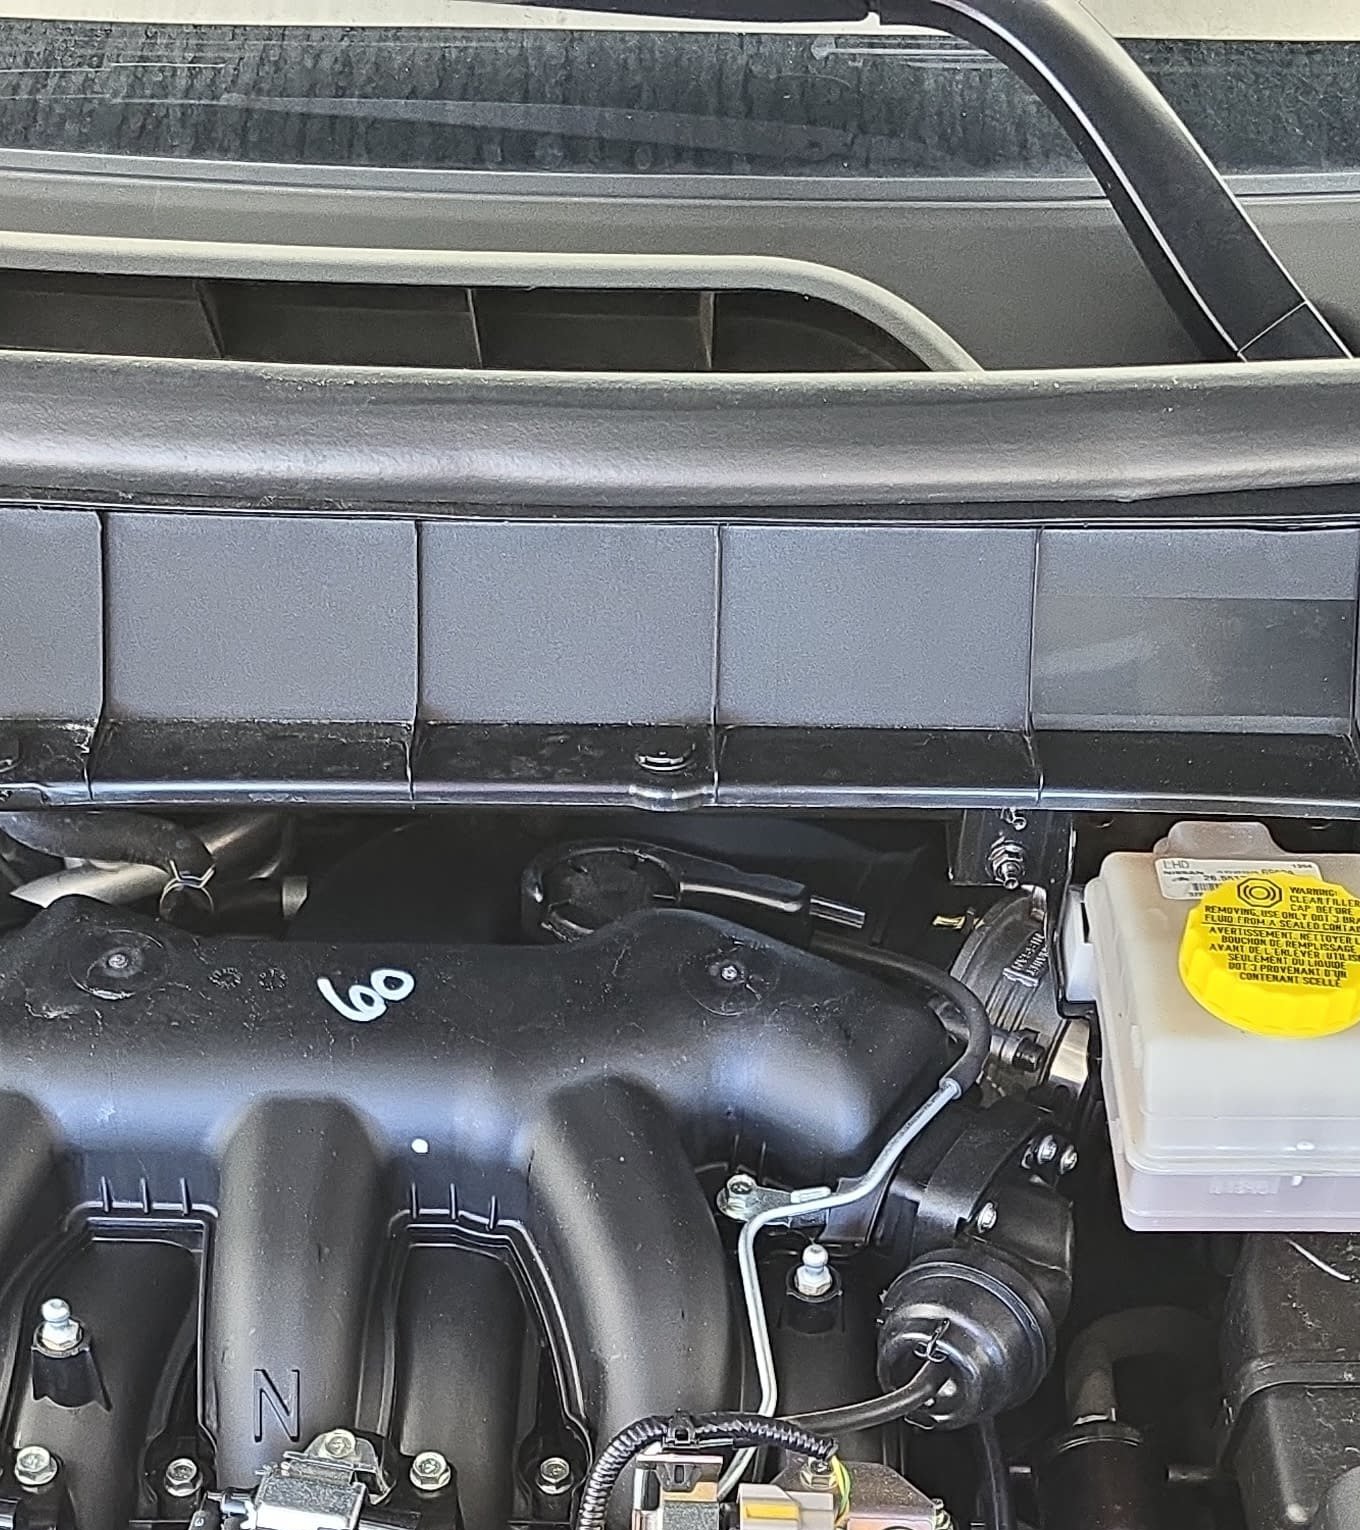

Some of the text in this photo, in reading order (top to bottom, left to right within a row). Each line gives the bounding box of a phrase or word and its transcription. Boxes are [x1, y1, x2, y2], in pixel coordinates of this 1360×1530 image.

[1163, 860, 1190, 869] LHD
[1290, 895, 1360, 908] CLEAN FILLER
[1261, 910, 1280, 918] USE
[1281, 911, 1307, 920] ONLY
[1311, 913, 1329, 922] DOT
[1333, 915, 1339, 923] 3
[1290, 904, 1353, 916] CAP BEFORE
[1205, 914, 1233, 923] FLUID
[1238, 916, 1265, 926] FROM
[1280, 920, 1319, 930] SEALED
[1222, 935, 1356, 953] BOUCHON DE REMPLISSAGE
[1300, 933, 1351, 944] NETTOYER
[1209, 944, 1244, 953] AVANT
[1249, 946, 1261, 955] DE
[1228, 953, 1346, 970] SEULEMENT DU LIQUIDE
[1228, 962, 1248, 971] DOT
[1251, 963, 1257, 972] 3
[1260, 964, 1320, 976] PROVENANT
[1240, 972, 1299, 985] CONTENANT
[317, 969, 415, 1022] 60
[253, 1368, 300, 1443] N
